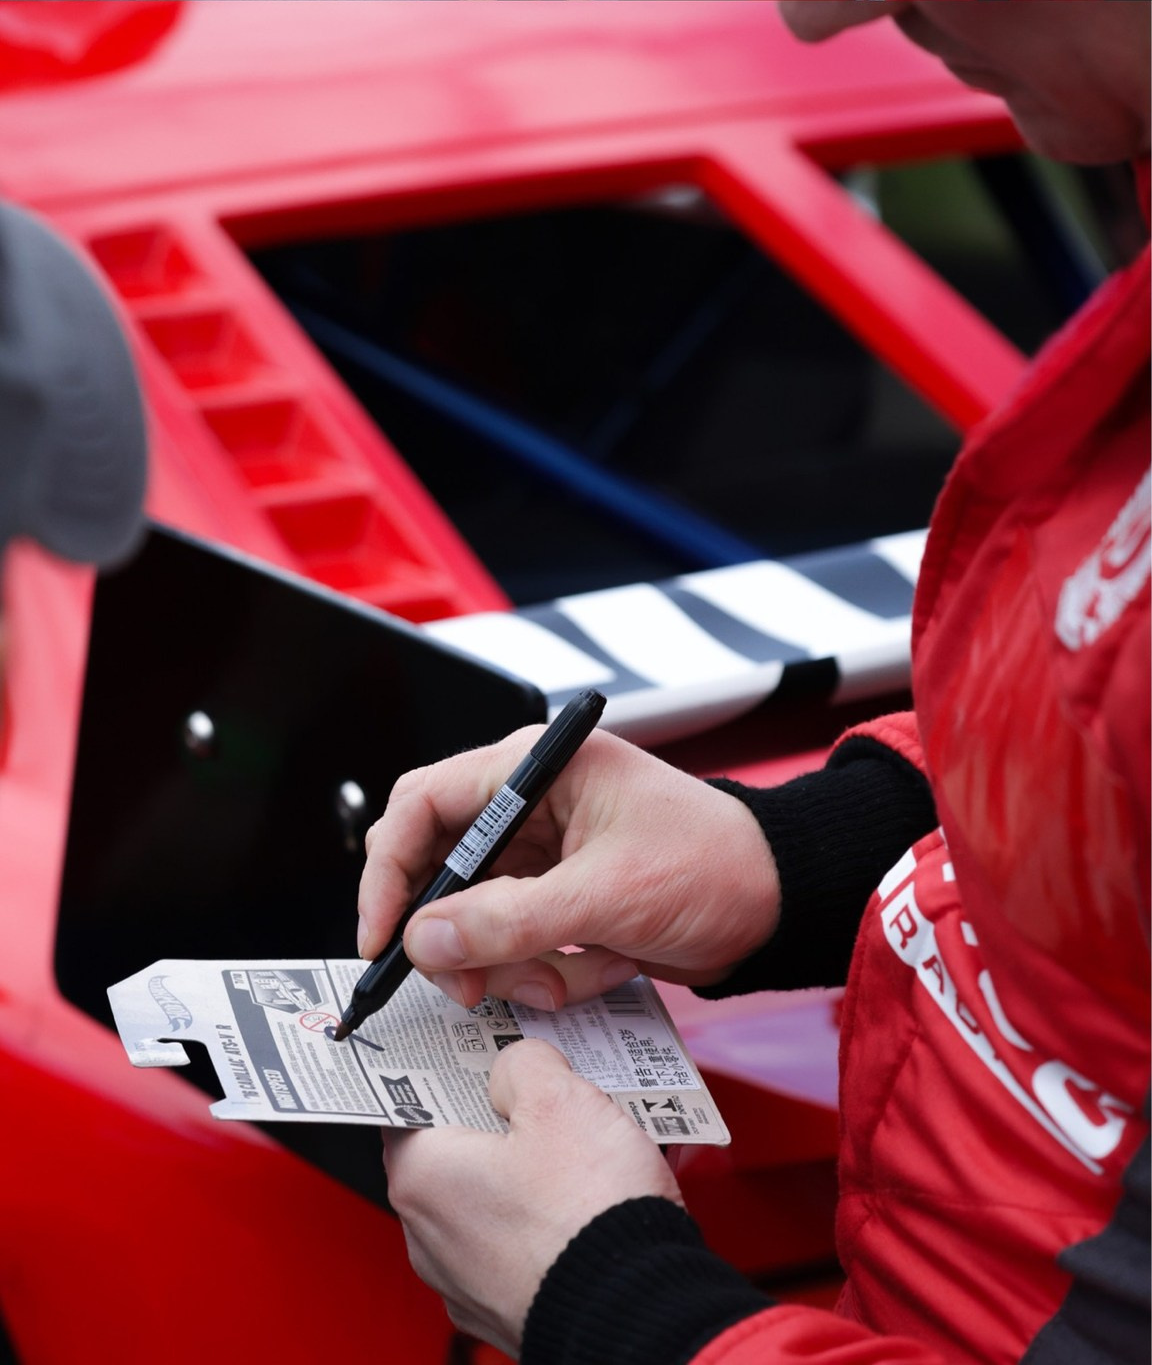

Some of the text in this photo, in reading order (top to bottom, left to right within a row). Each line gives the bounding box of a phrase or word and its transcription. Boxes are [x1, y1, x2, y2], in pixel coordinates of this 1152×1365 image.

[461, 802, 521, 878] 3 245676 454512
[231, 1059, 257, 1092] CADILLAC
